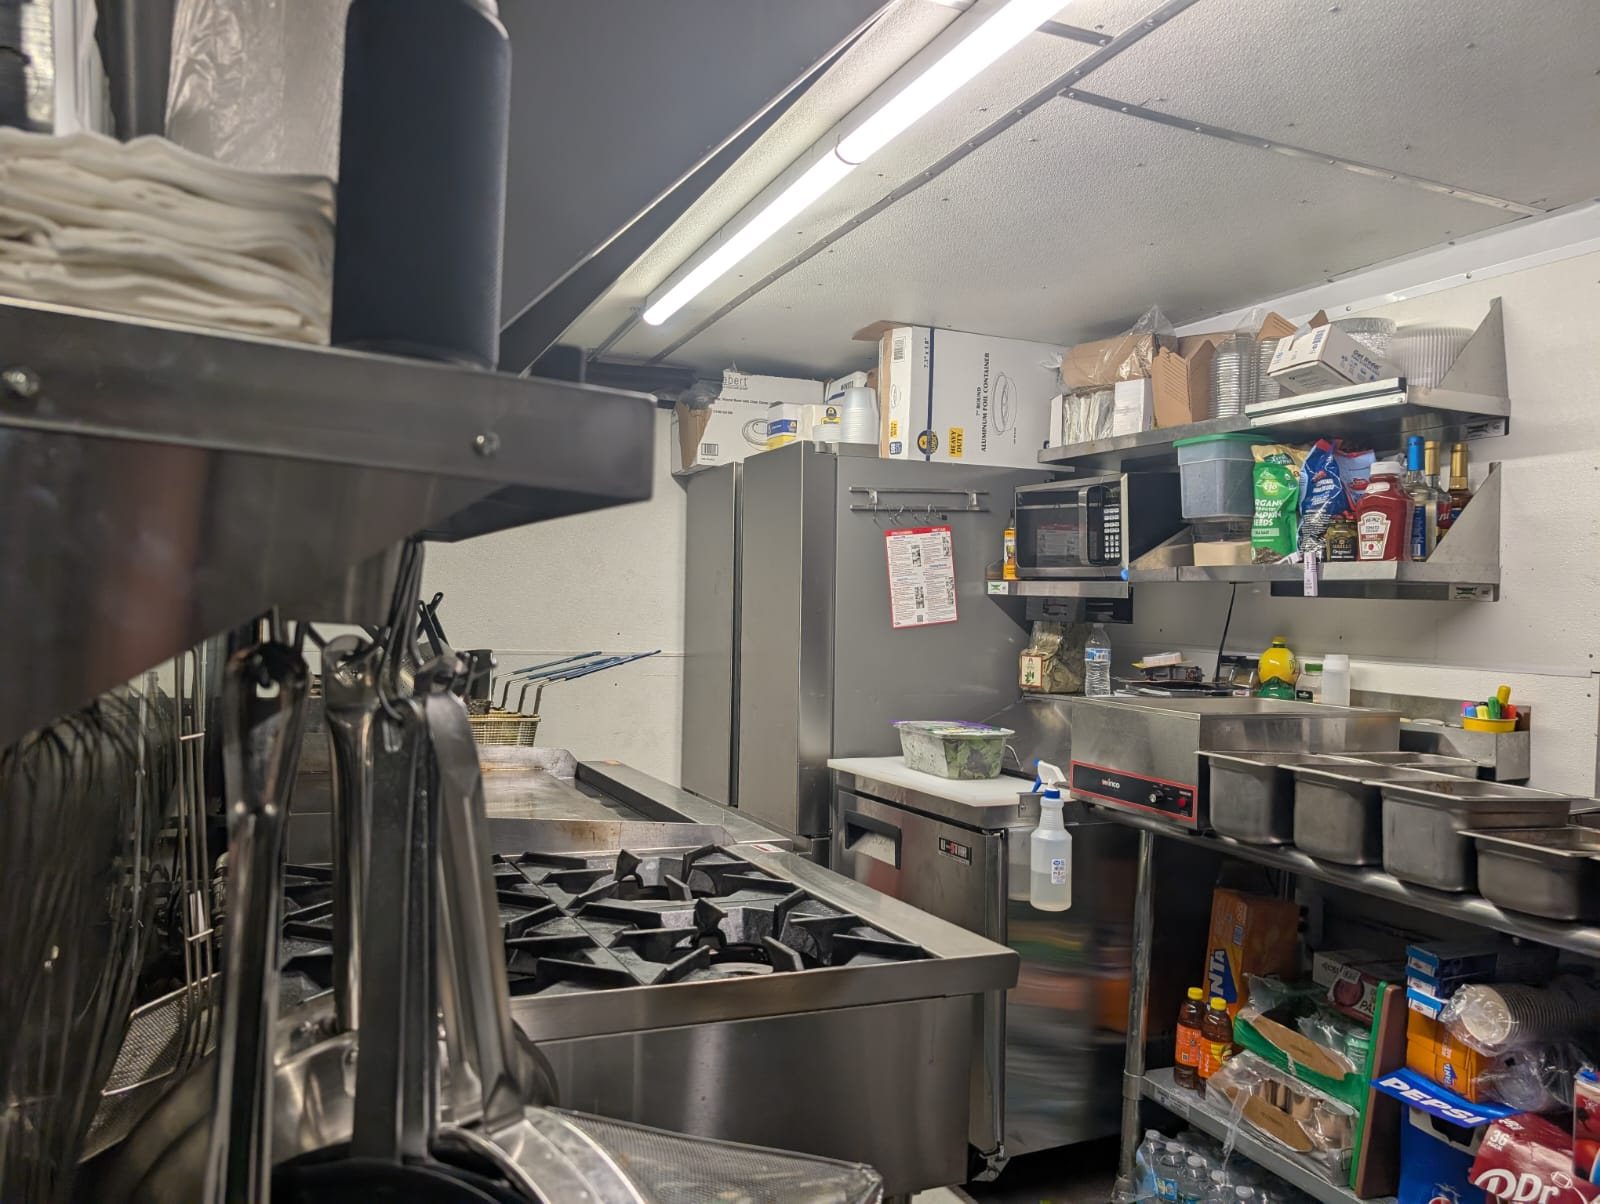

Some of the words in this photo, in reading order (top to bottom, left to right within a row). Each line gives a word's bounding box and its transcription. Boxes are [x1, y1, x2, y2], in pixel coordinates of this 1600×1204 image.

[1101, 778, 1121, 790] winco
[1209, 950, 1225, 996] NTA
[1380, 1077, 1488, 1124] PEPSI
[1489, 1129, 1510, 1146] 36
